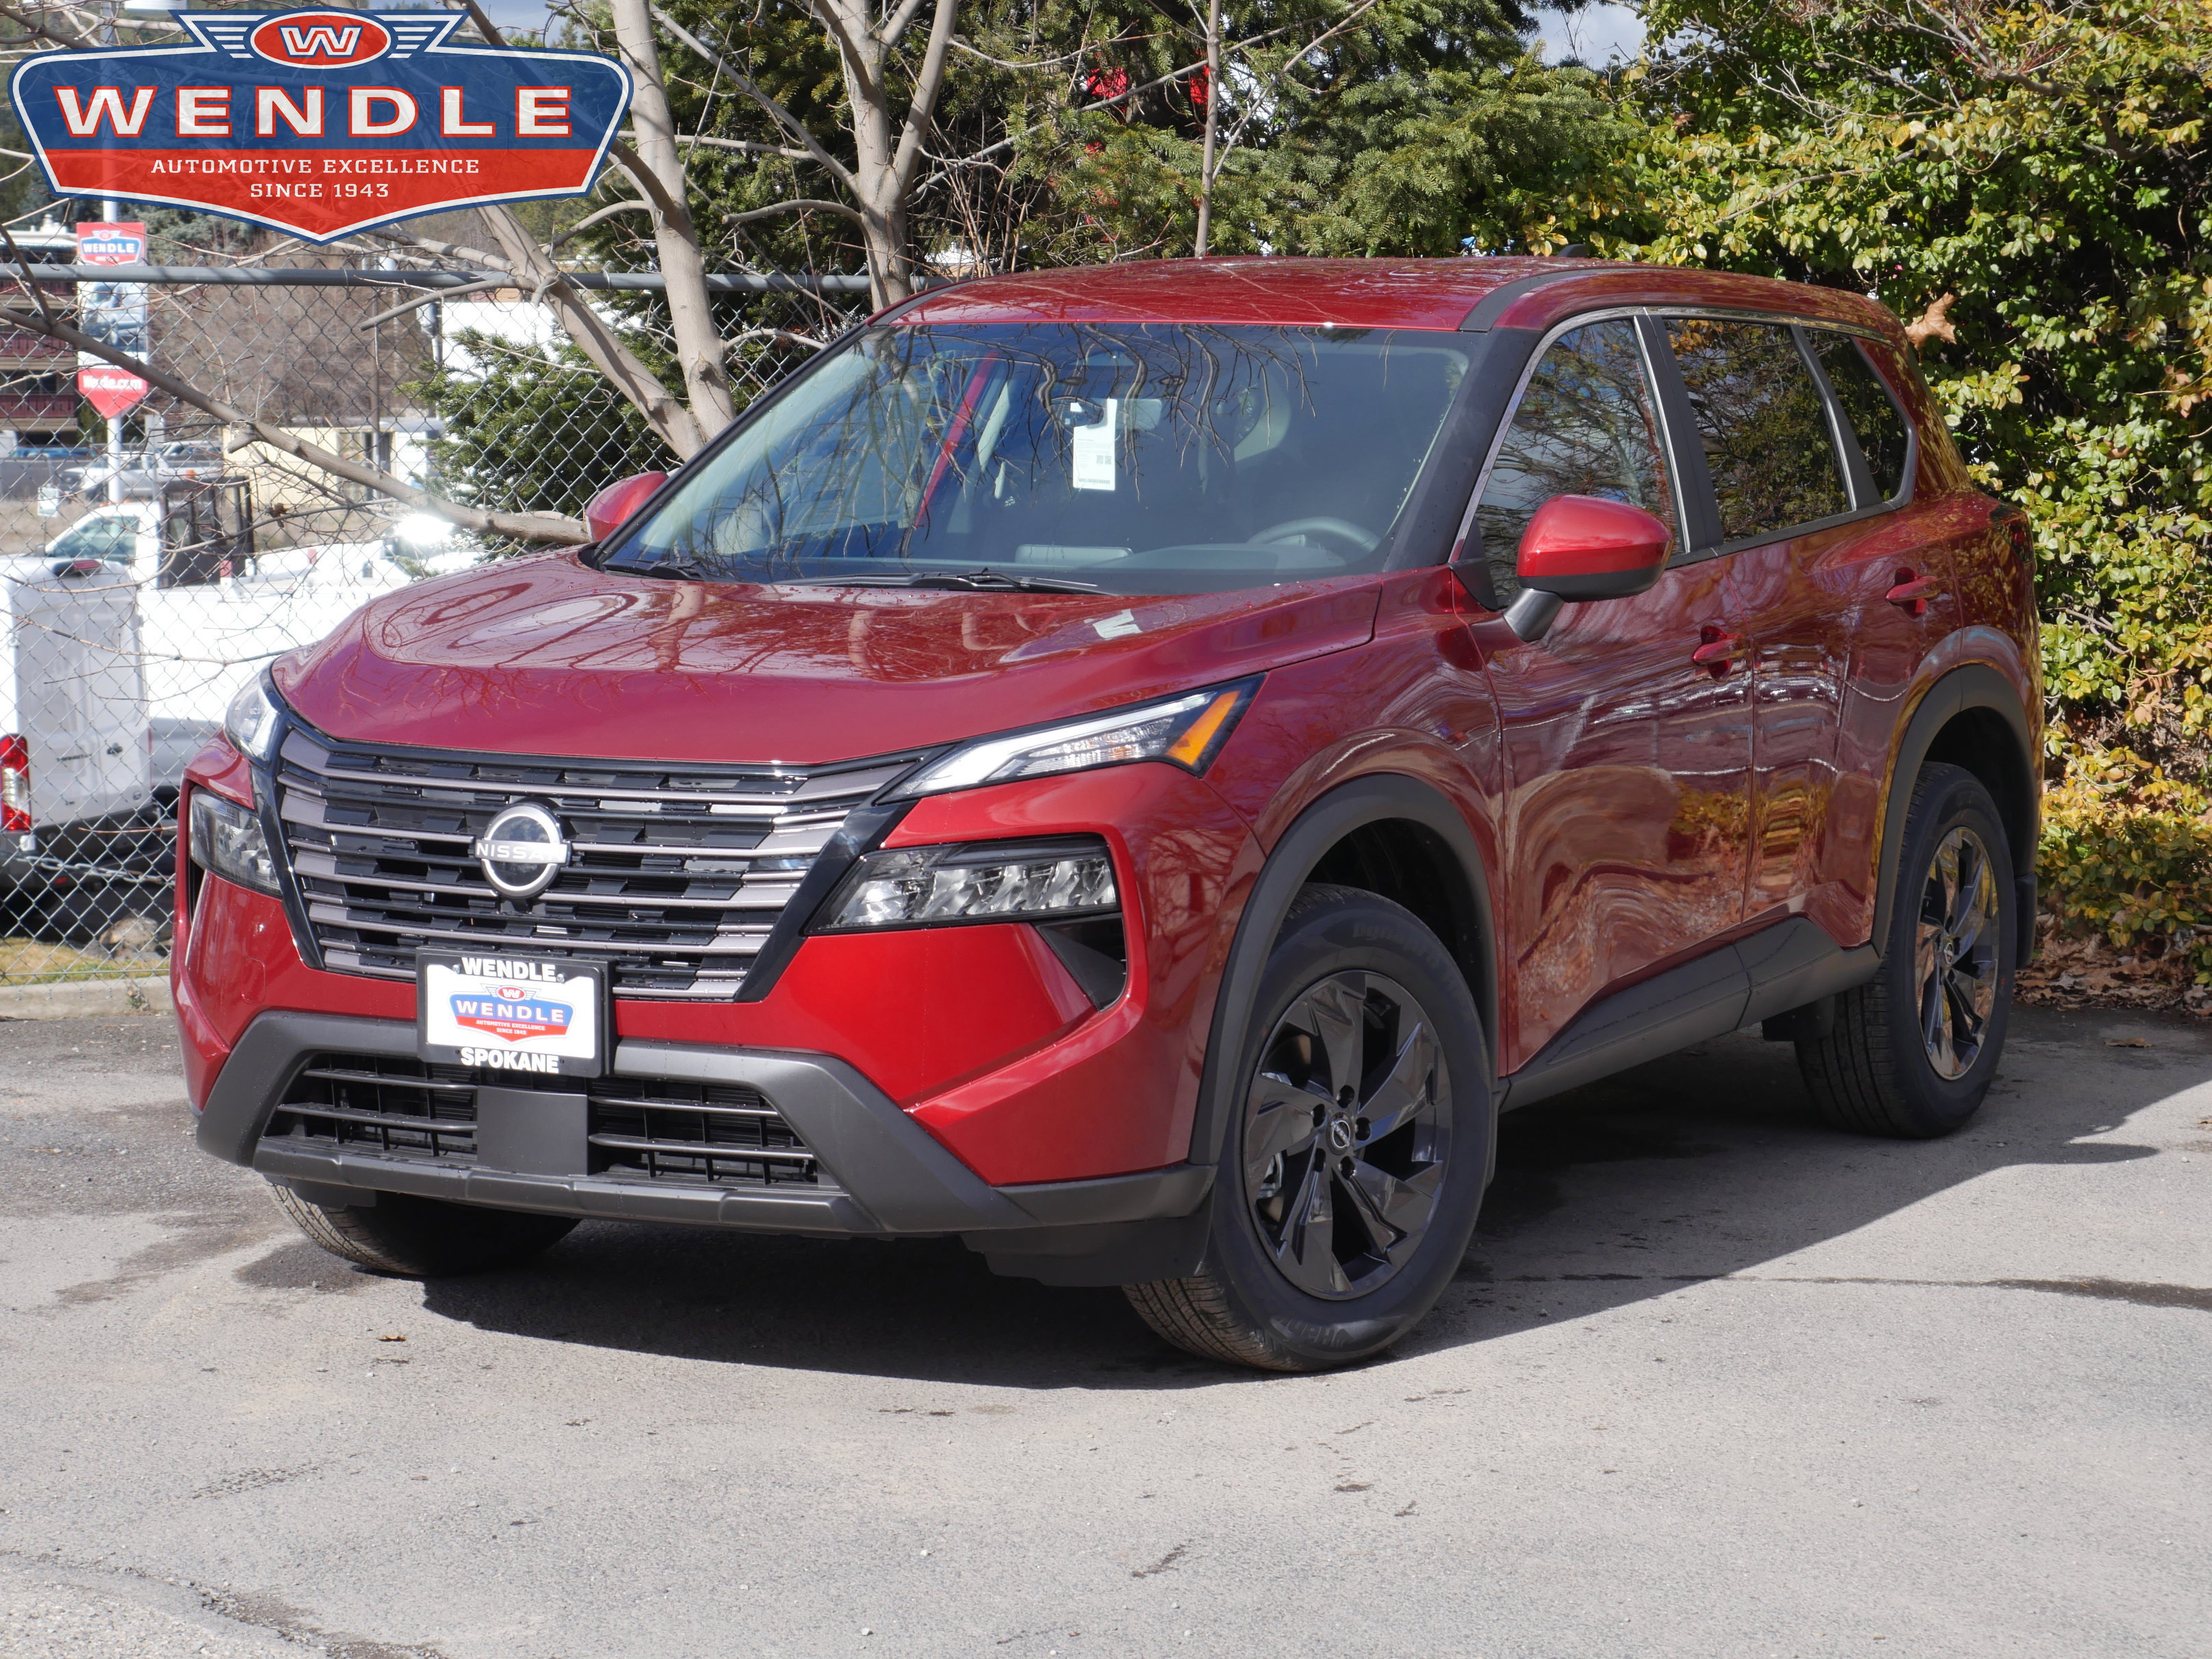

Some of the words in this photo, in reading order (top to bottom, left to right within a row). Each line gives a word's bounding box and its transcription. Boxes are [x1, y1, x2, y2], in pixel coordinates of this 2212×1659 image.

[83, 243, 135, 253] WENDLE
[476, 843, 563, 861] NISSA
[461, 957, 556, 982] WENDLE
[455, 1000, 564, 1023] WENDLE
[460, 1047, 559, 1073] SPOKANE
